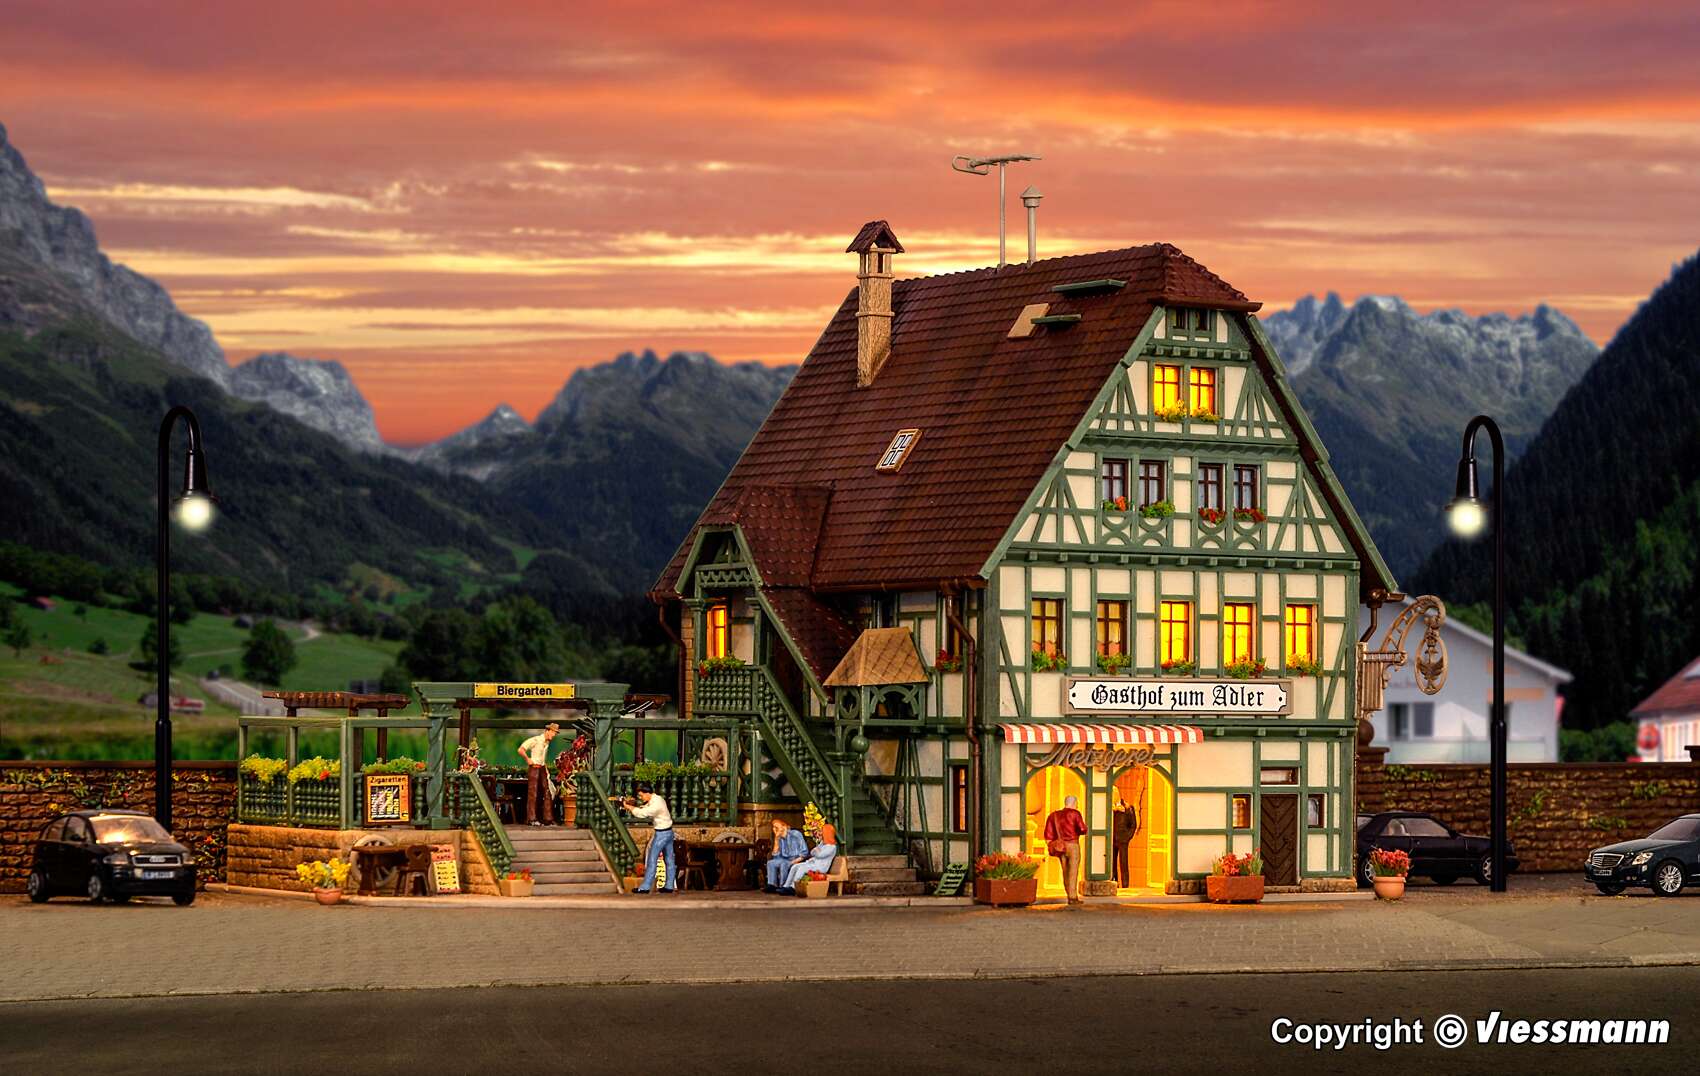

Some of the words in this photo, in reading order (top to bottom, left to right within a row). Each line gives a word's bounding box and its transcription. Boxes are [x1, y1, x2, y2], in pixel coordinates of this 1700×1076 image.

[497, 685, 552, 697] Biergarten
[1091, 684, 1164, 711] Gasthof
[1170, 690, 1204, 710] zum
[1212, 684, 1265, 707] Adler
